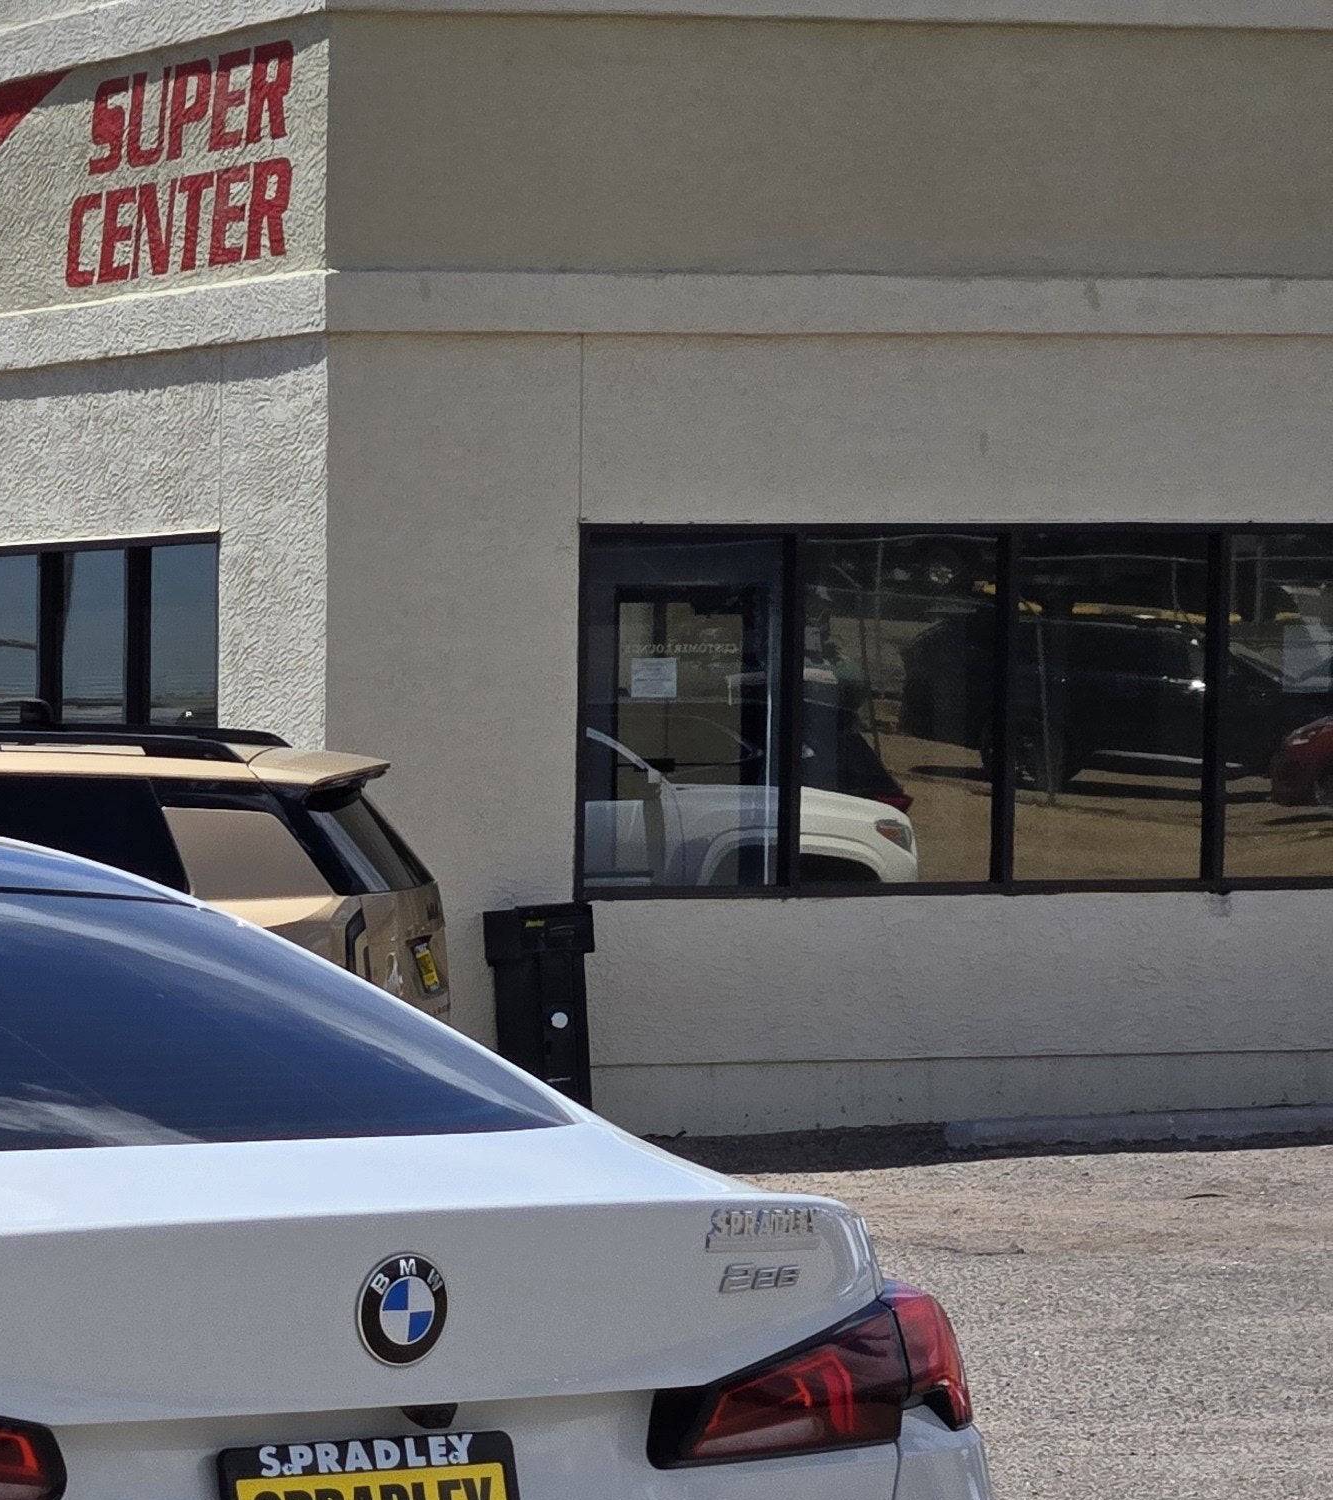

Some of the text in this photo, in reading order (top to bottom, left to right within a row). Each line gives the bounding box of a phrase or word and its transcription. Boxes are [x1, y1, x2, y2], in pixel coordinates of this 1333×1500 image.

[88, 39, 294, 176] SUPER
[66, 156, 293, 288] CENTER
[370, 1258, 444, 1296] BMW
[258, 1433, 473, 1477] SPRADLEY
